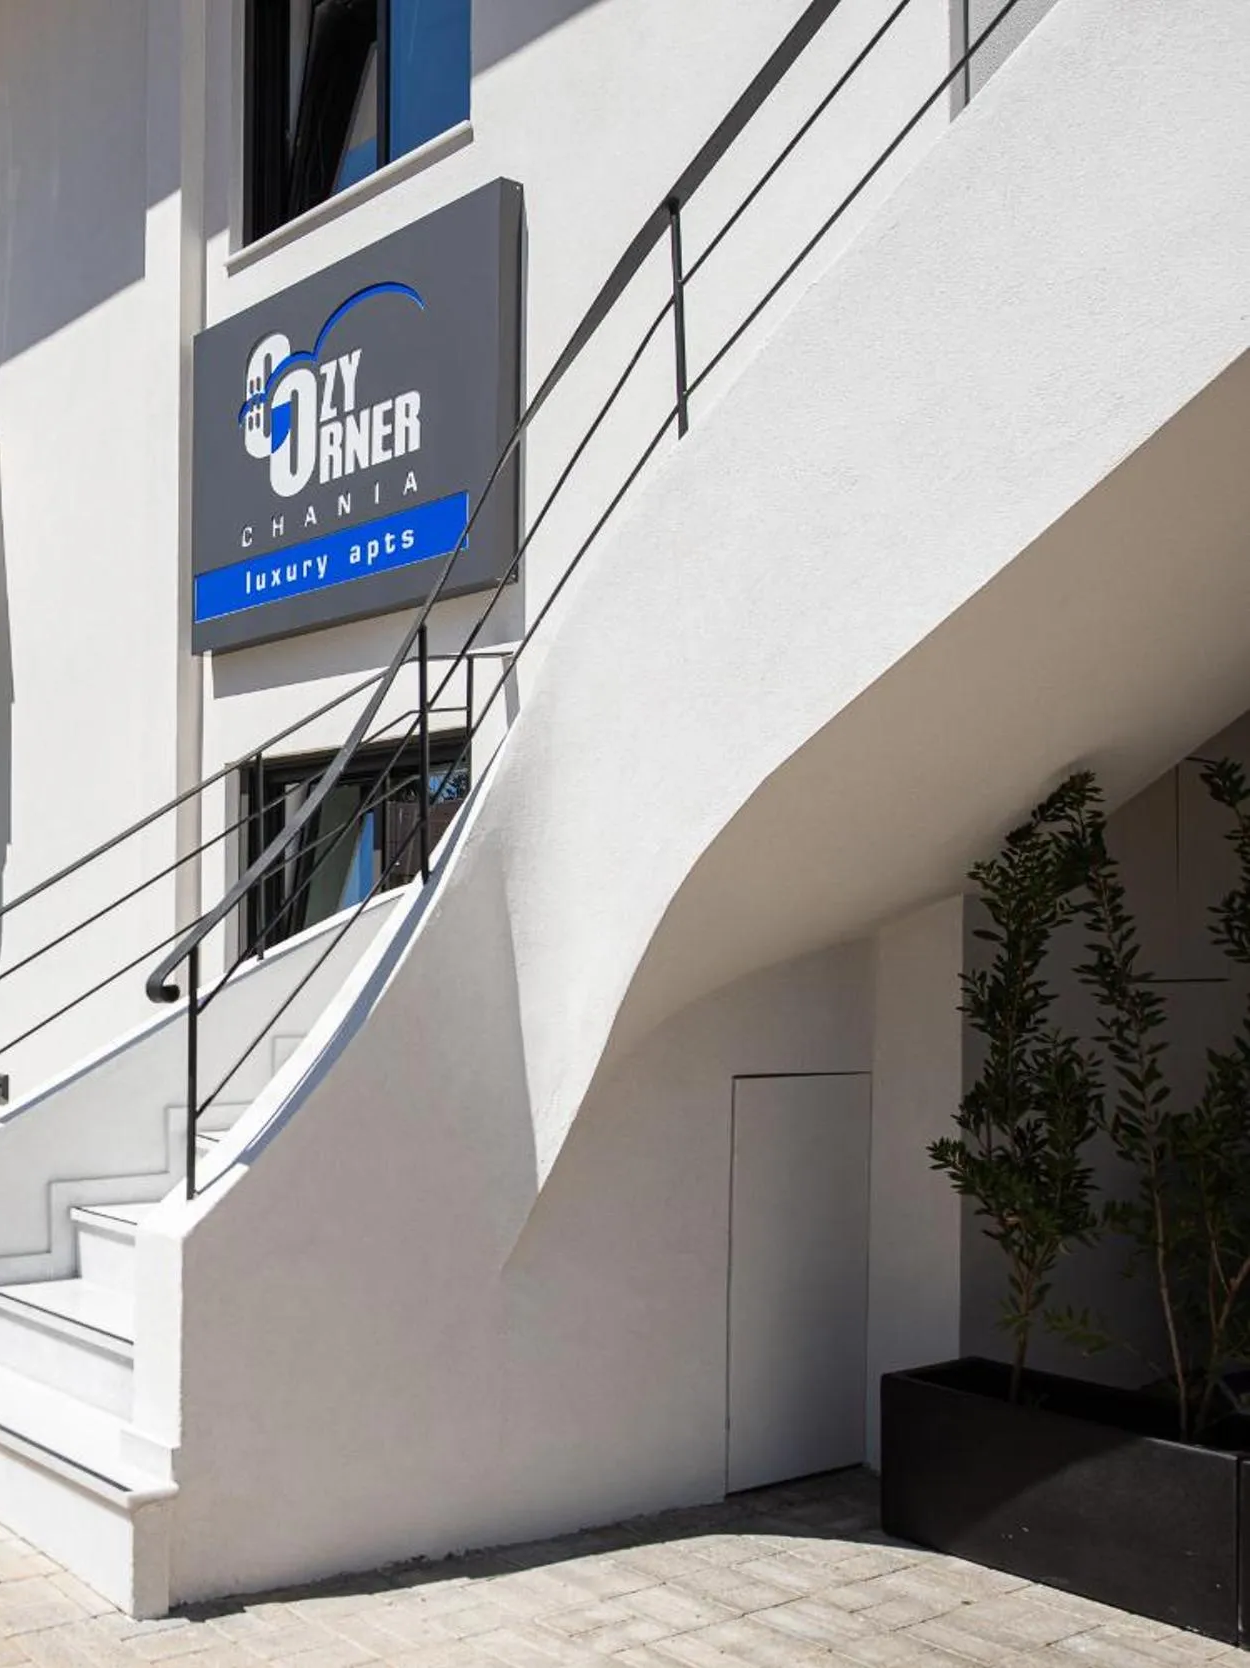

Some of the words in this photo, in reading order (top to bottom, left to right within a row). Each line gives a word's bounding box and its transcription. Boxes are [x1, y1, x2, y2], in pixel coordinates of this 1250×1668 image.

[241, 470, 418, 548] CHANIA
[245, 554, 328, 595] luxury
[349, 528, 415, 566] apts
